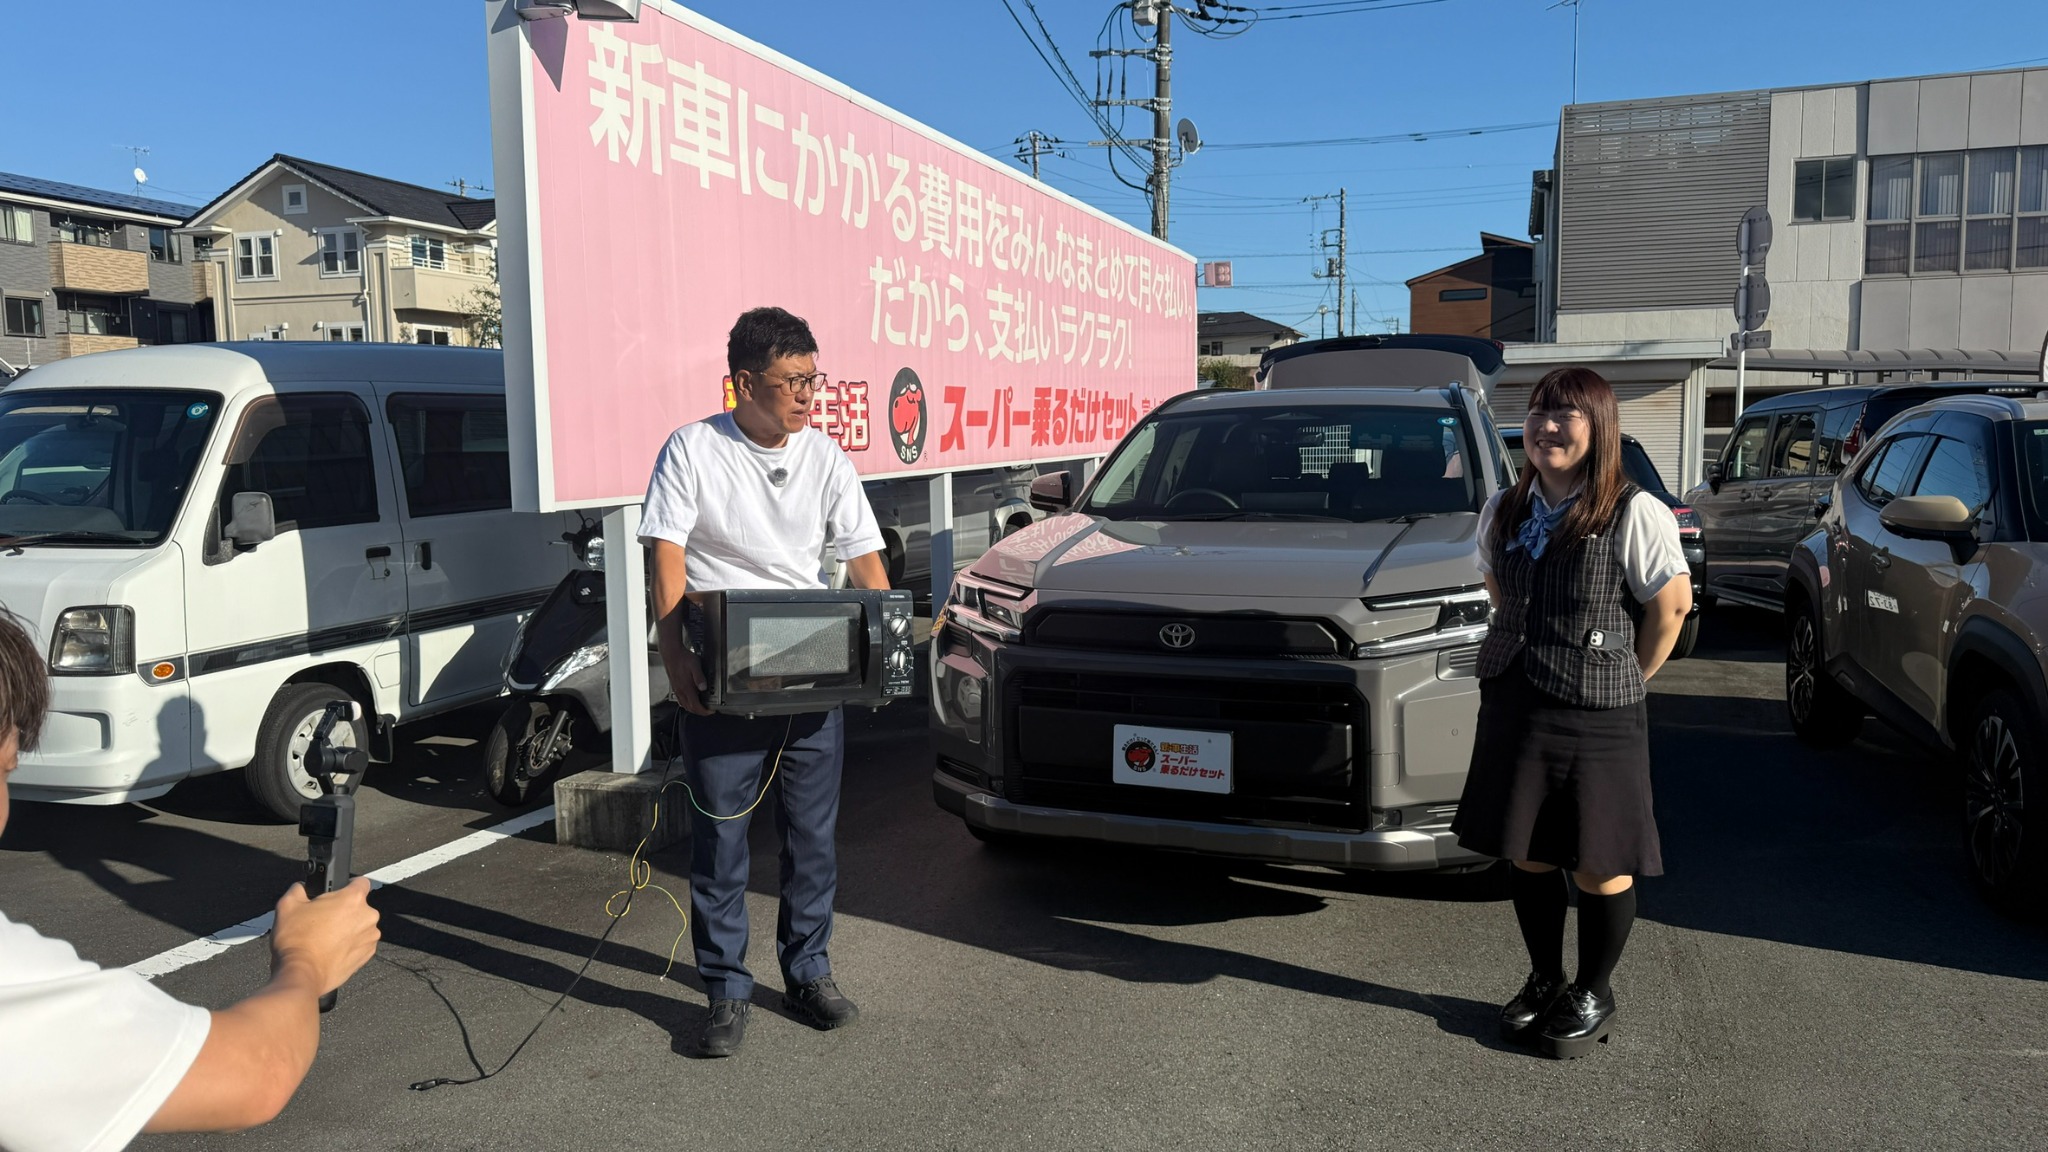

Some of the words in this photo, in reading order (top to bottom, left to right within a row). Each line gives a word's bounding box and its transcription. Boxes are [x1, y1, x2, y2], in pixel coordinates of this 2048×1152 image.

[588, 22, 1192, 323] 新車にかかる費用をみんなまとめて月々払い。
[940, 386, 1138, 453] スーパー乗るだけセット
[900, 445, 918, 462] SNS
[1160, 754, 1198, 766] スーパー
